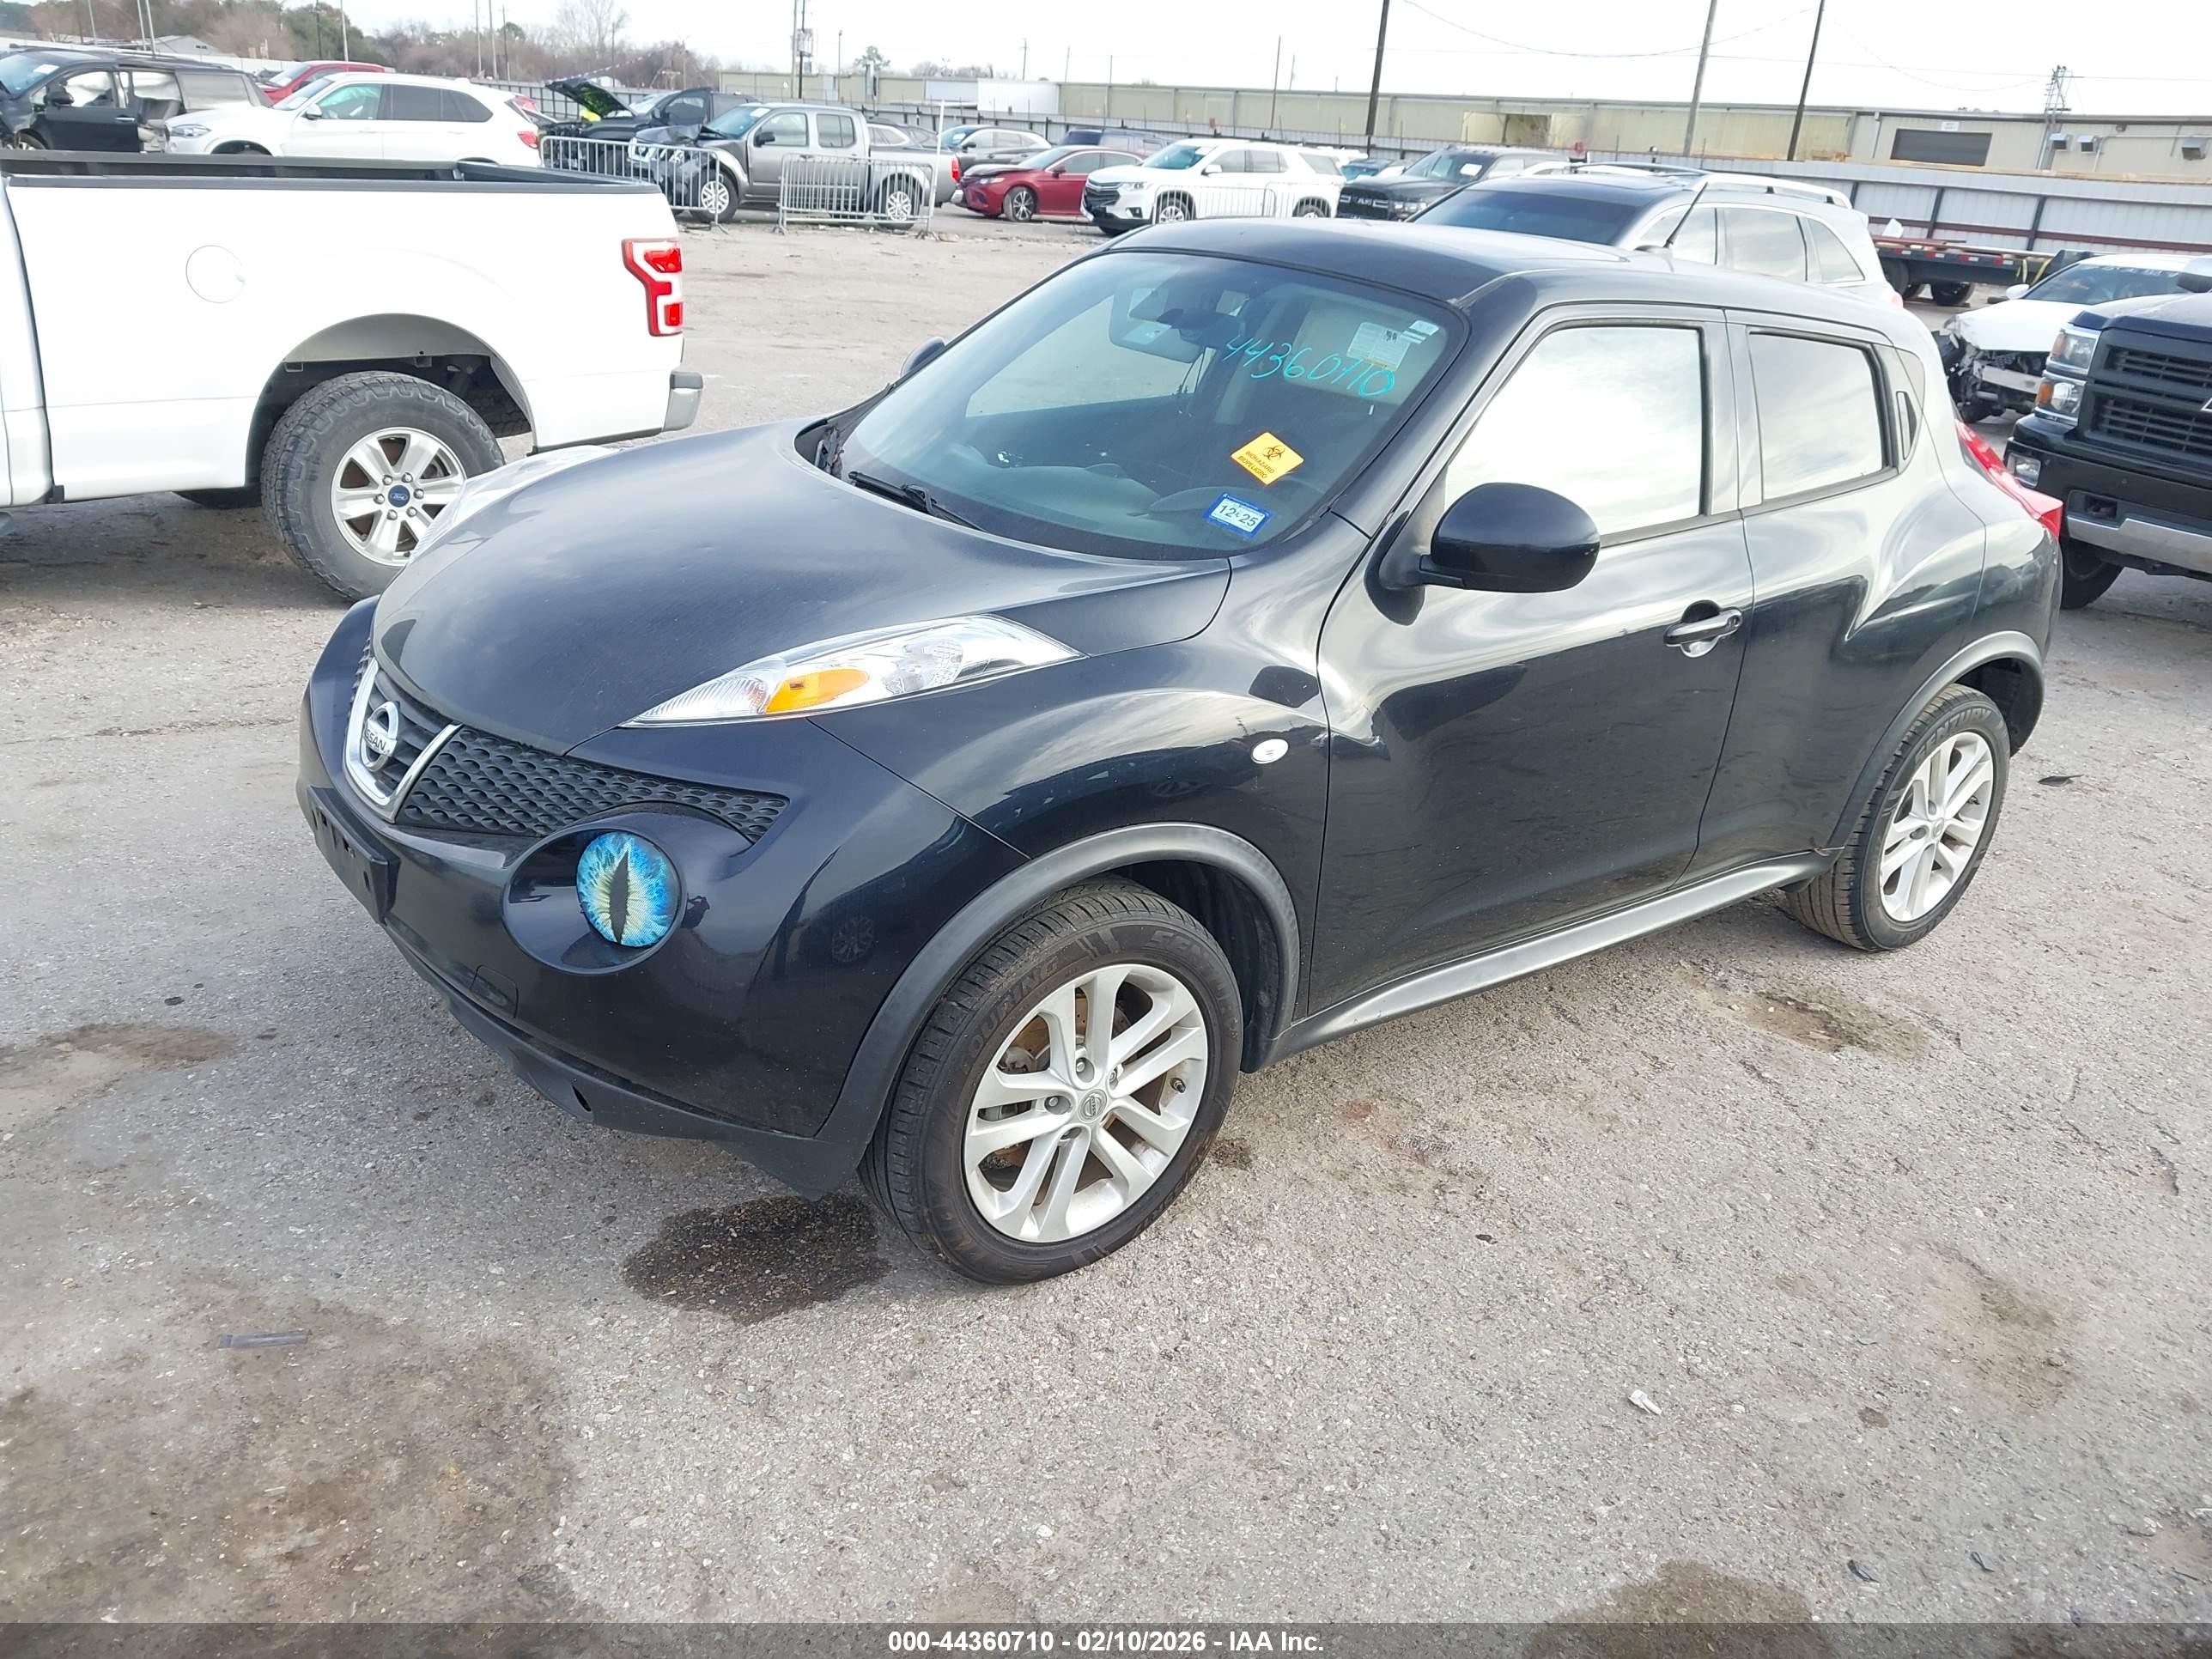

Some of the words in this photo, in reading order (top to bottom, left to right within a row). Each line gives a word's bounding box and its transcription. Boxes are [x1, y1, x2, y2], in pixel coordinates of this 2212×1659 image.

[1222, 334, 1395, 398] 44360710
[364, 728, 386, 751] SSAN
[957, 951, 1060, 1072] OURING
